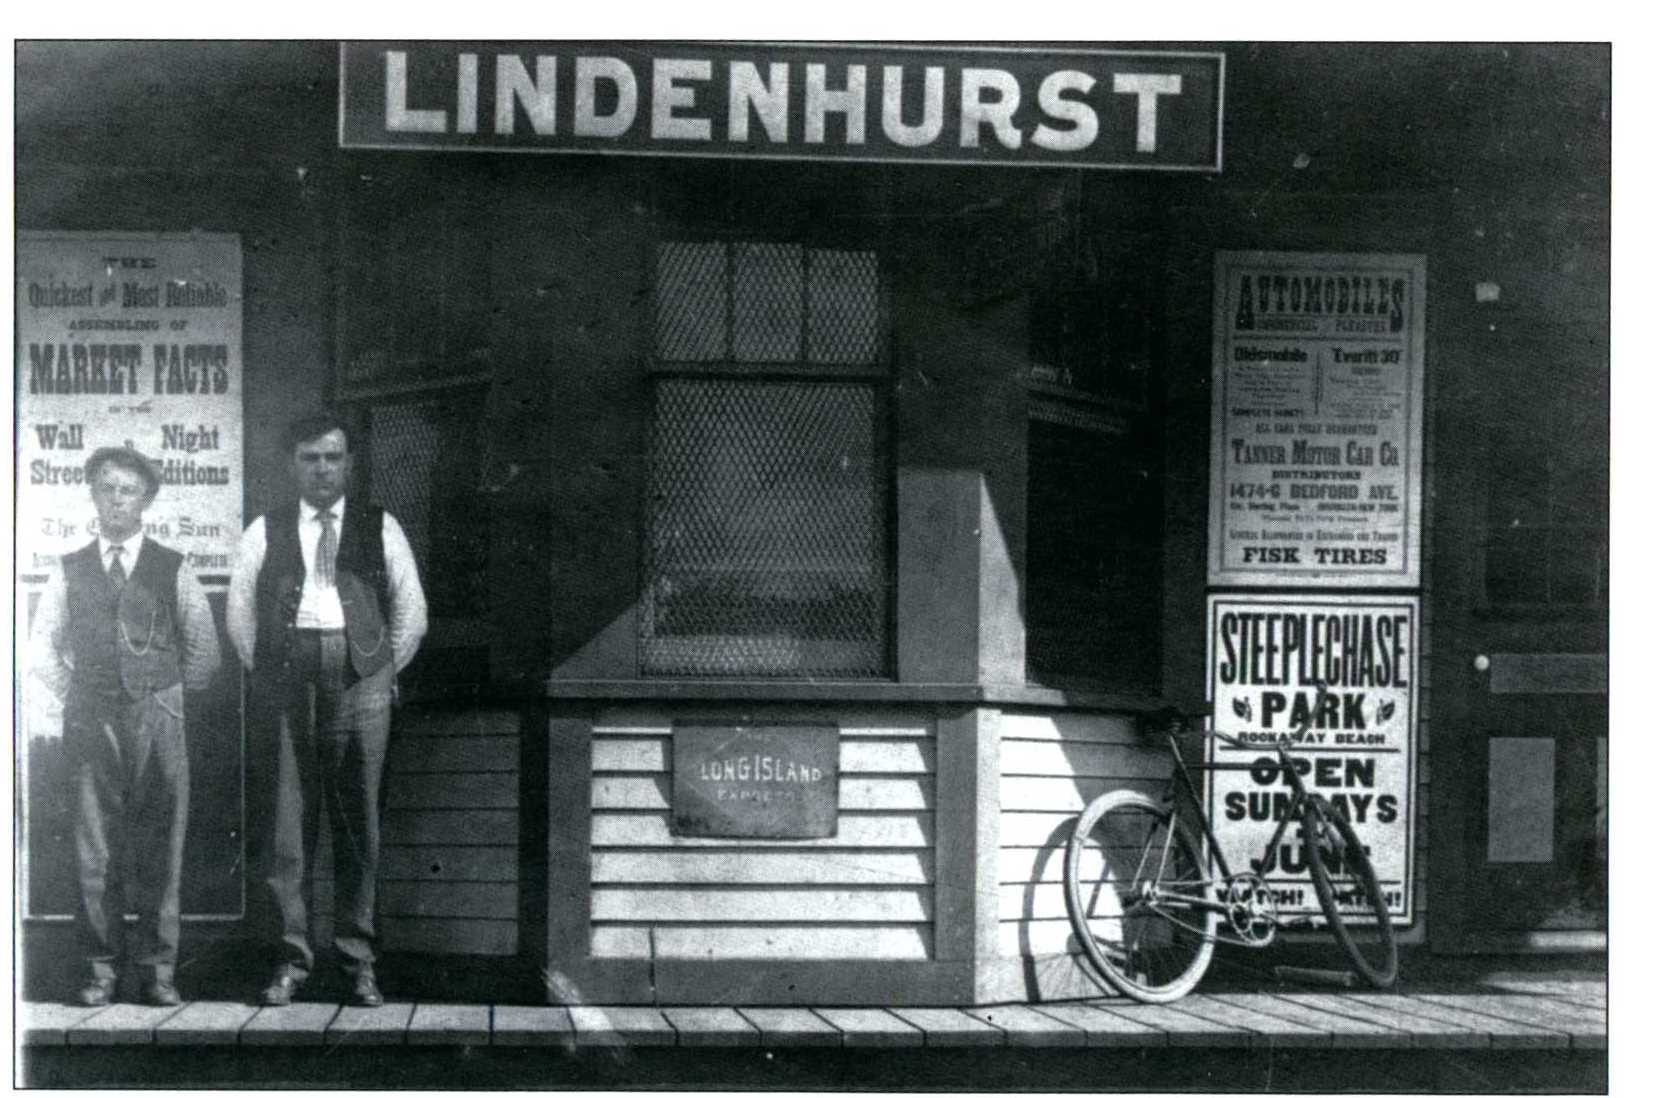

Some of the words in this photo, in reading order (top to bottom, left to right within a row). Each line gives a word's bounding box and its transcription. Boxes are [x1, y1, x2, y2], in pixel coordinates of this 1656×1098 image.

[384, 50, 1182, 154] LINDENHURST
[103, 257, 157, 269] THE
[29, 281, 93, 309] Quickest
[122, 282, 160, 309] Most
[166, 281, 228, 308] Reliable
[1235, 275, 1405, 333] AUTOMOBILES
[169, 319, 188, 331] OF
[29, 343, 143, 395] MARKET
[152, 343, 229, 395] FACTS
[35, 423, 85, 450] Wall
[160, 423, 220, 454] Night
[30, 458, 88, 485] Stree
[1290, 483, 1359, 499] BEDFORD
[40, 517, 77, 538] The
[177, 515, 221, 537] Sun
[1242, 547, 1300, 564] FISK
[1314, 547, 1388, 565] TIRES
[1220, 611, 1408, 689] STEEPLECHASE
[1261, 691, 1366, 730] PARK
[1335, 732, 1386, 745] BEACH
[701, 755, 751, 782] LONG
[755, 754, 823, 783] ISLAND
[1251, 756, 1375, 788] OPEN
